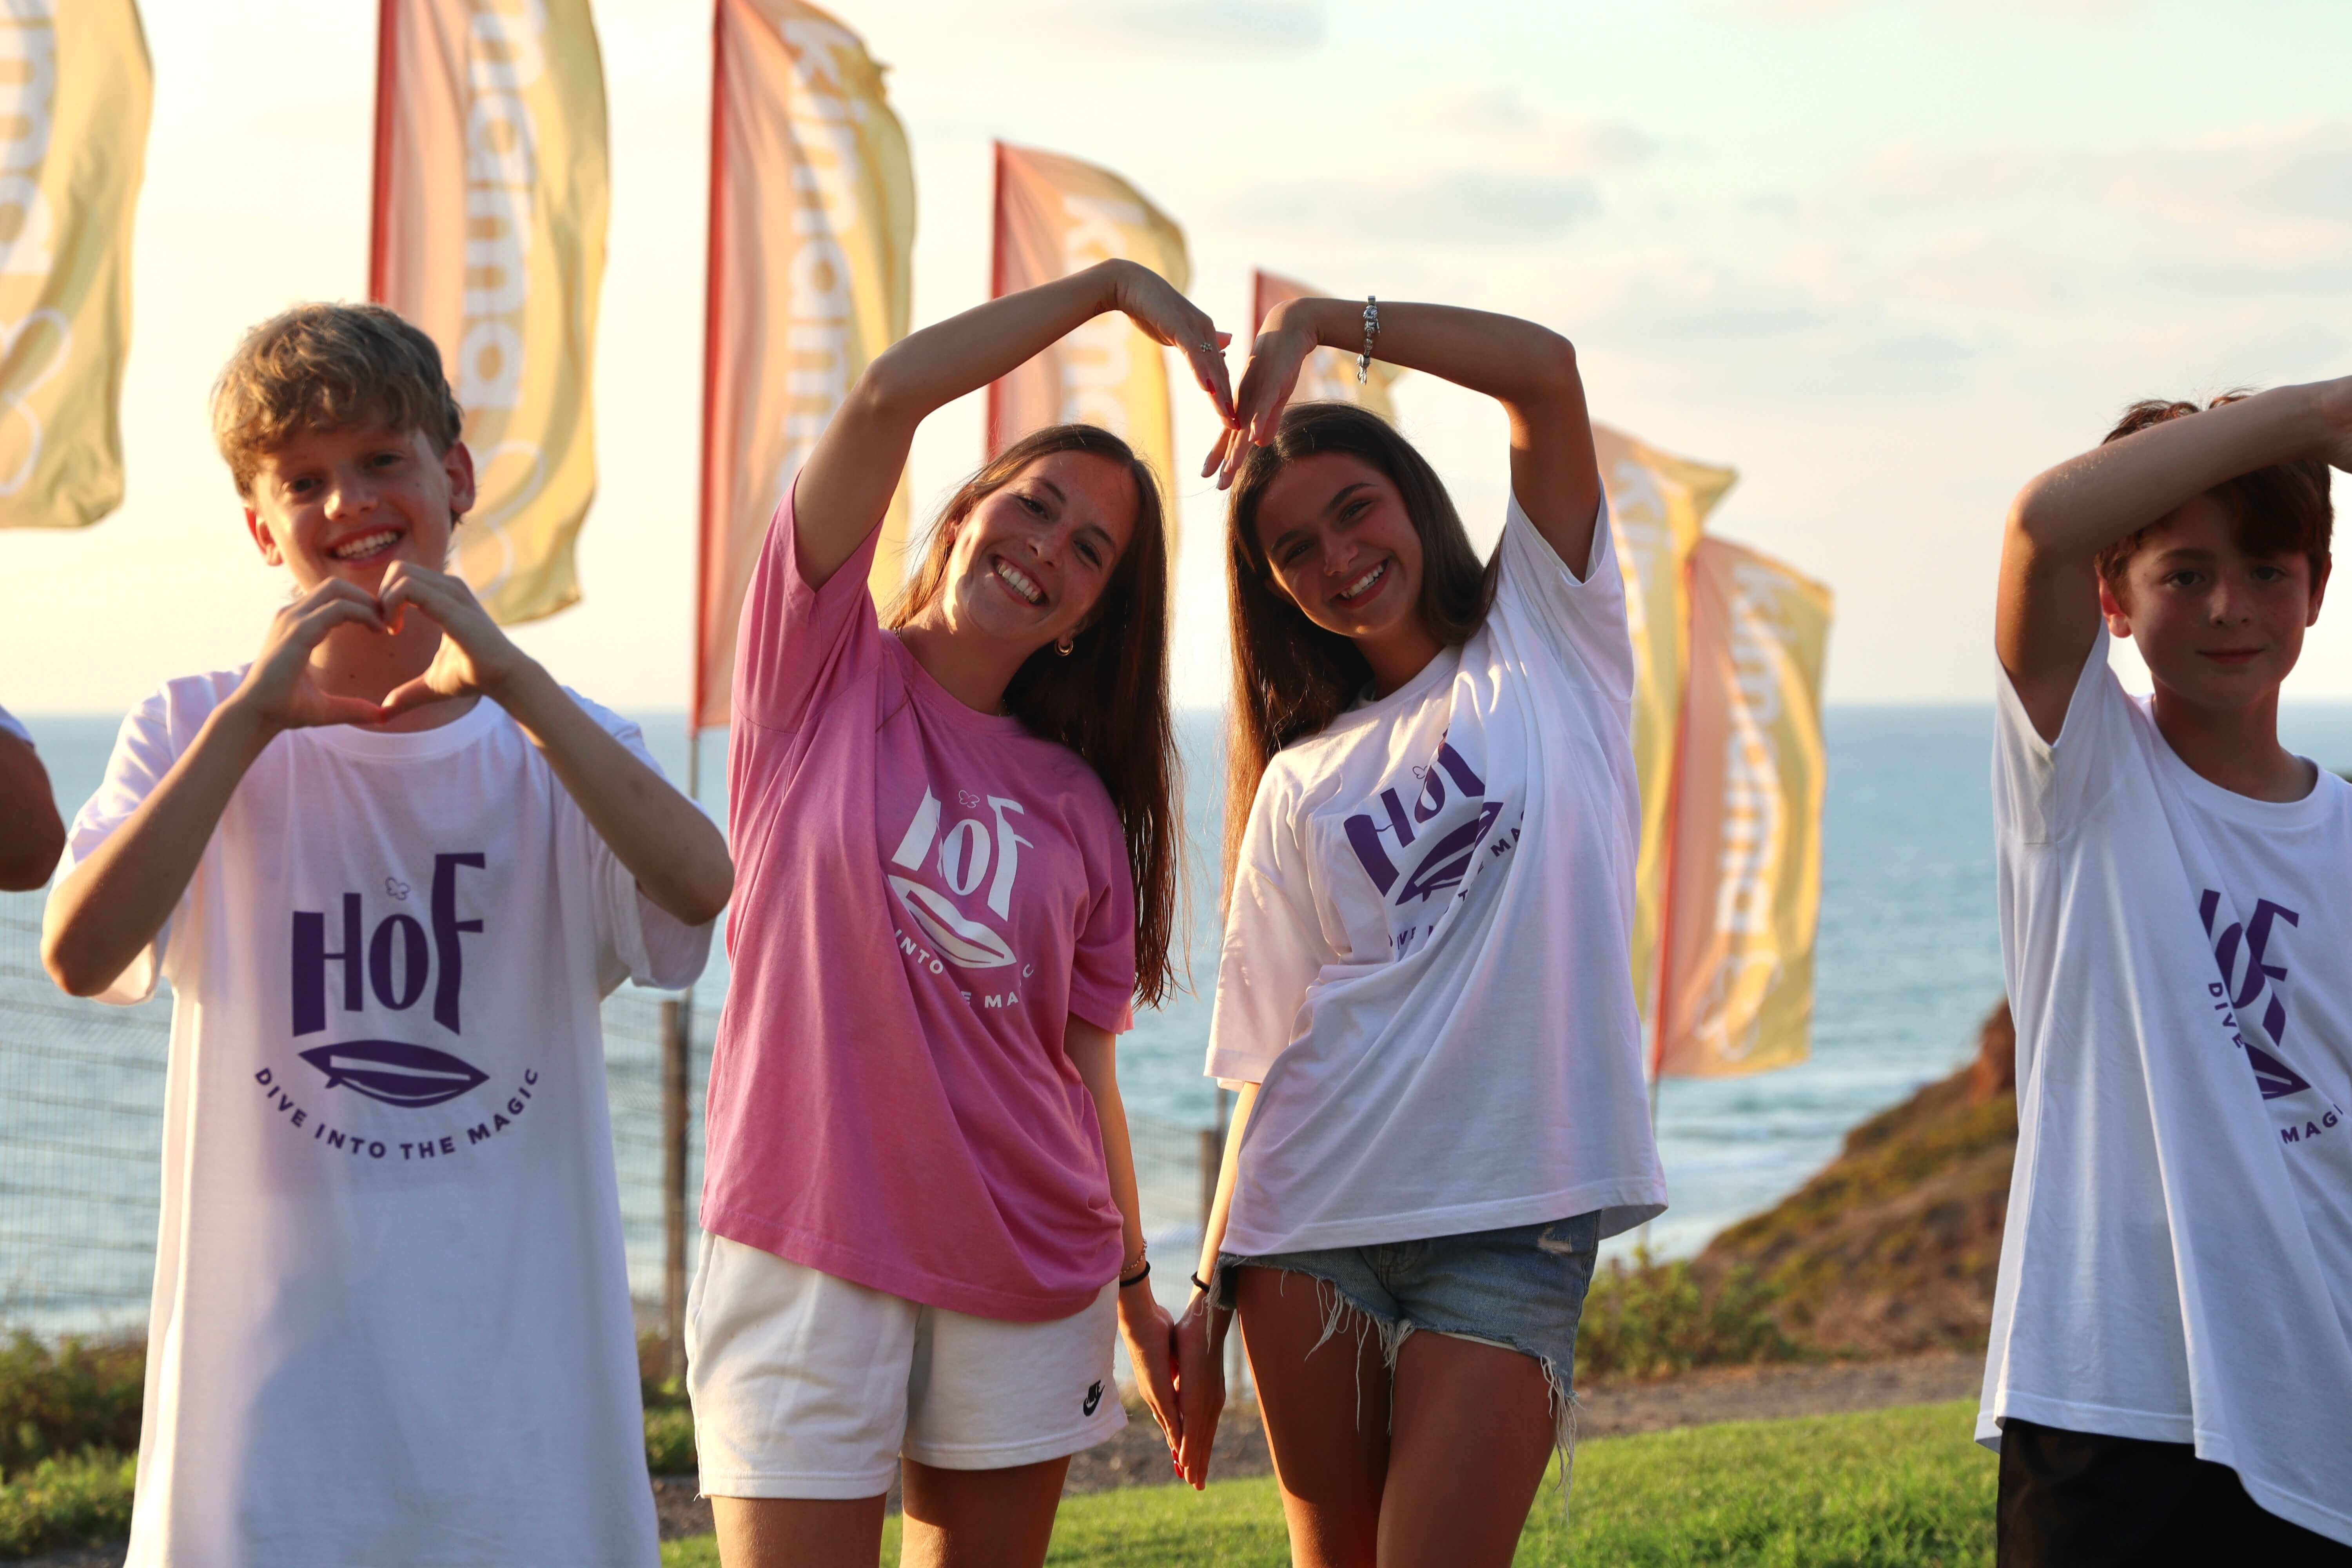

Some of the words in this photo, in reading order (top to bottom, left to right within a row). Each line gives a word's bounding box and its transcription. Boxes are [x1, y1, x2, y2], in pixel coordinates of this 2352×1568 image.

[984, 963, 1034, 1008] MAC
[254, 1067, 307, 1128] DIVE
[314, 1124, 387, 1159] INTO
[399, 1137, 456, 1160] THE
[466, 1068, 539, 1145] MAGIC
[2280, 1103, 2344, 1145] MAGI
